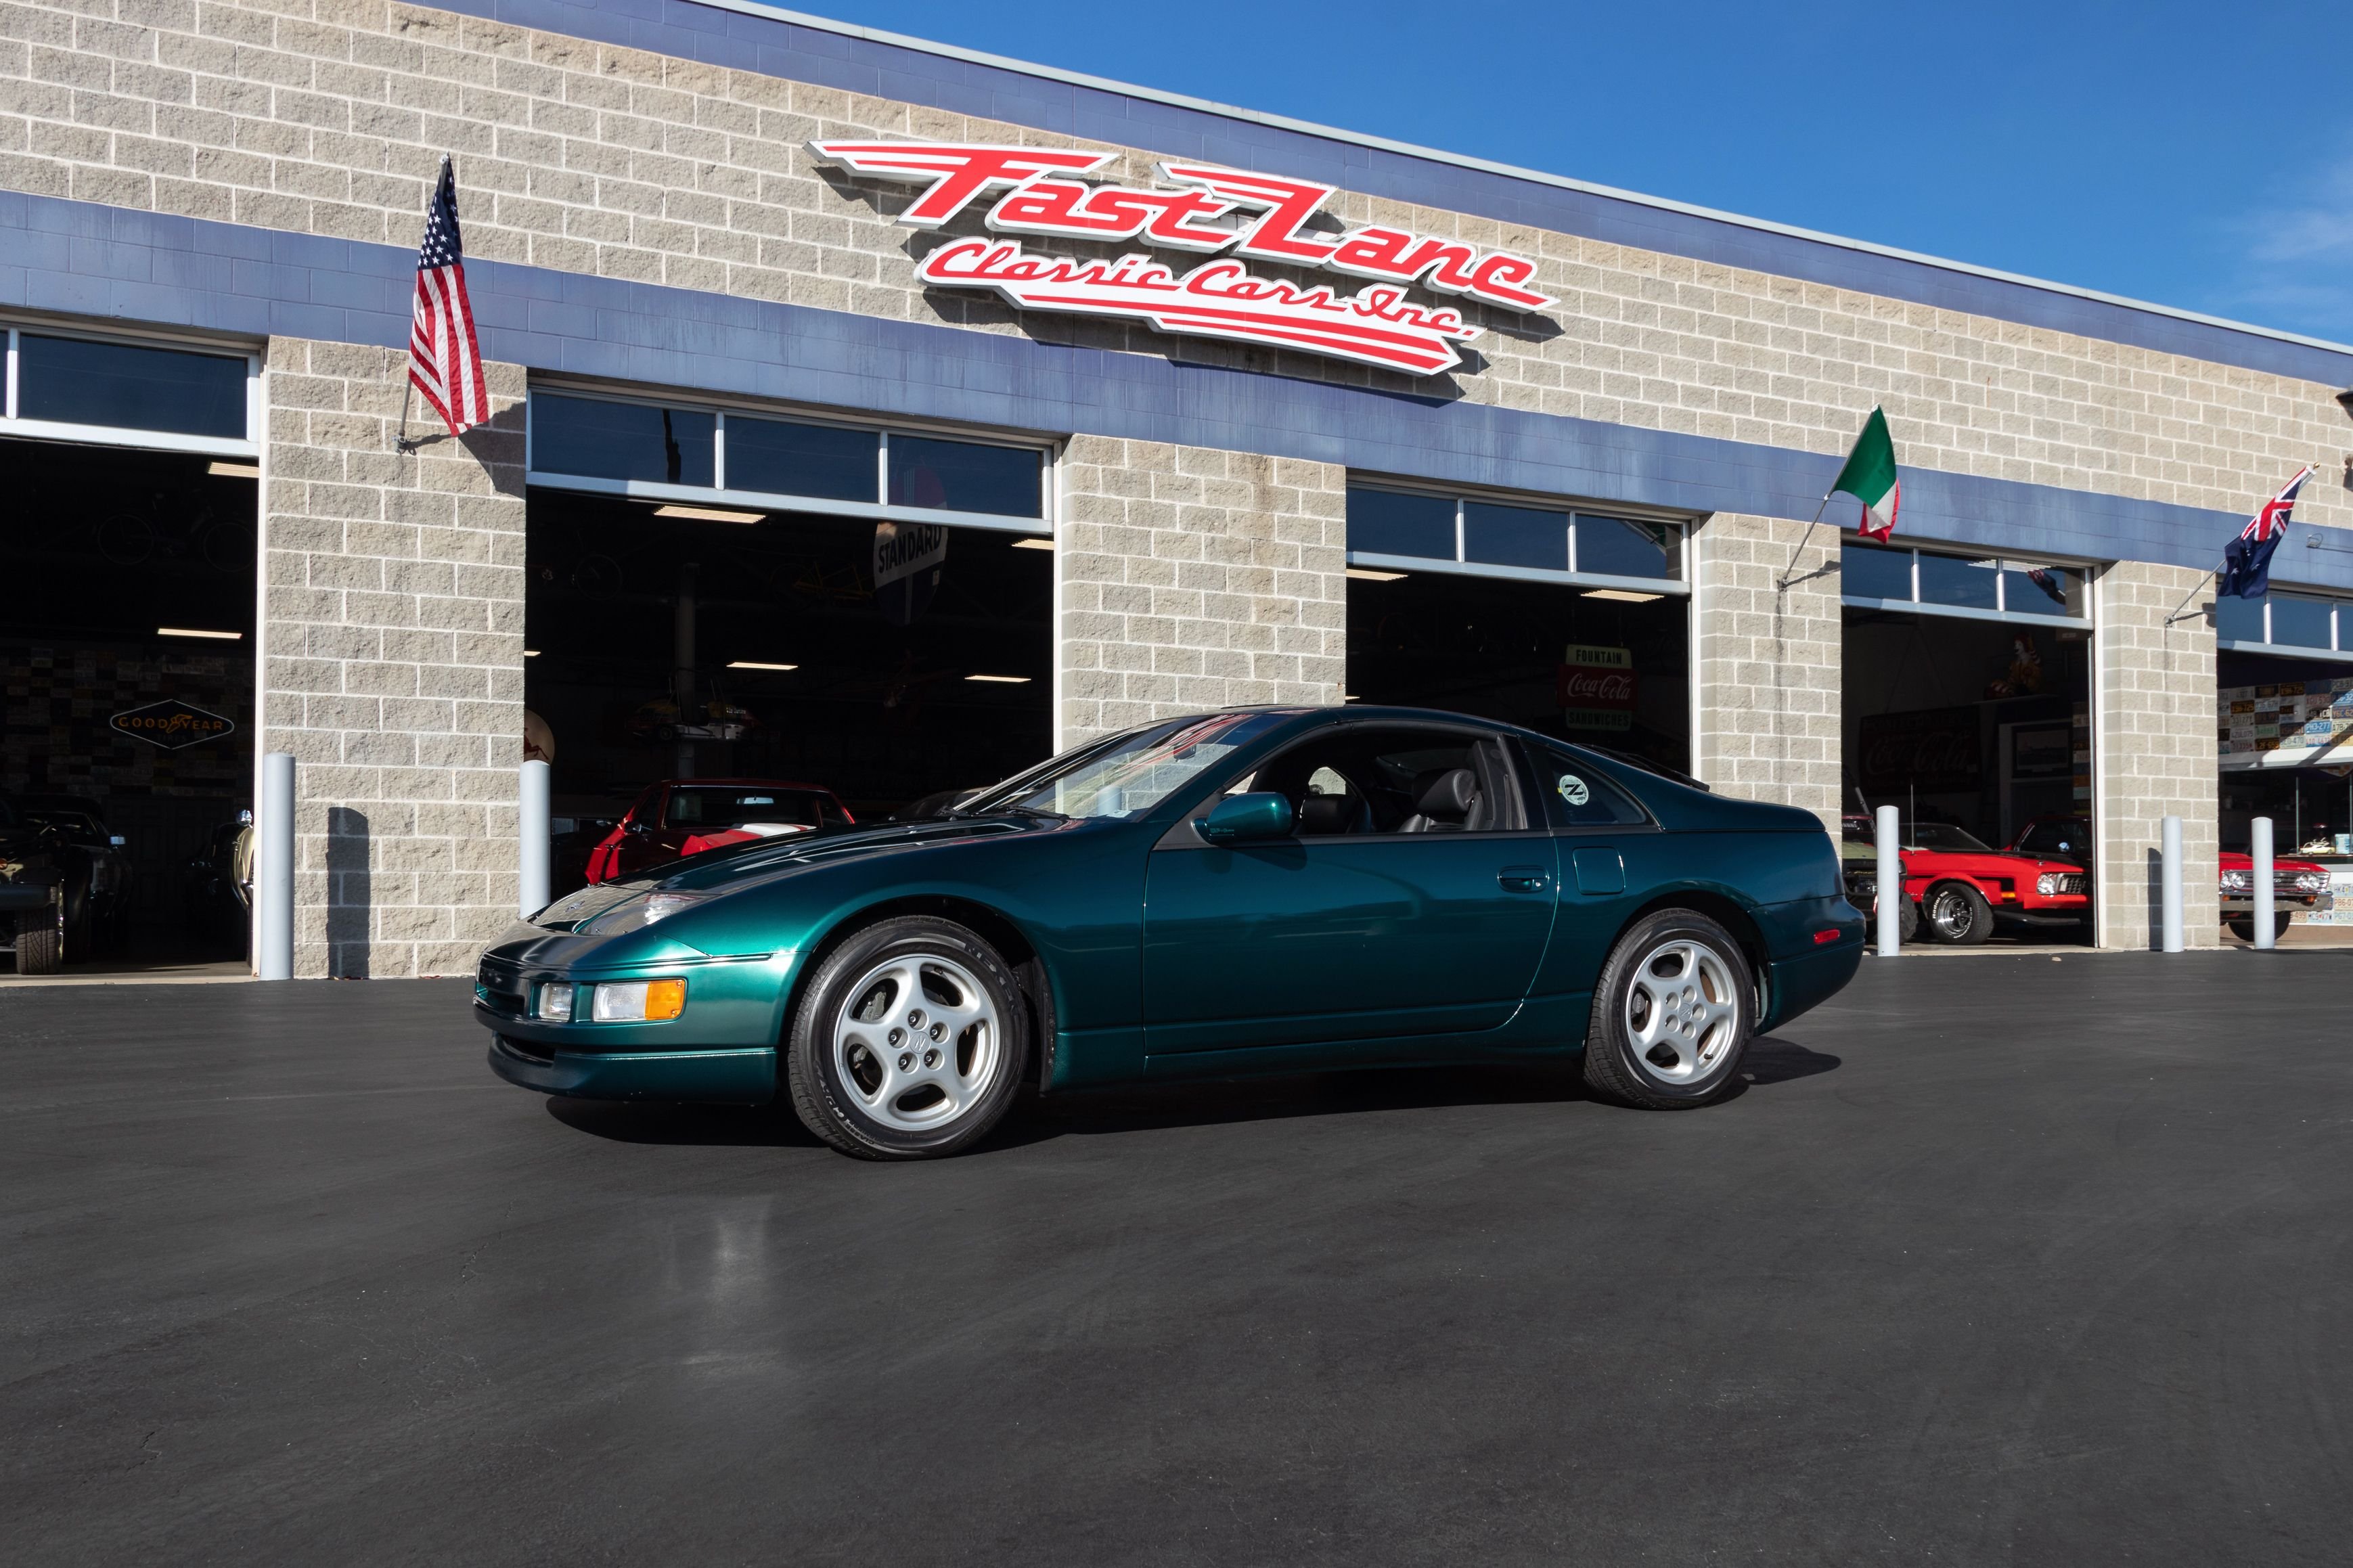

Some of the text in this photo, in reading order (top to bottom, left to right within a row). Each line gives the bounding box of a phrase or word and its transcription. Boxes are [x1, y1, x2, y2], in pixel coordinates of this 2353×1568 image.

[822, 144, 1550, 308] Fast Lane
[924, 243, 1475, 337] Classic Cars Inc.
[878, 524, 942, 574] STANDARD
[1576, 650, 1622, 665] FOUNTAIN
[1567, 673, 1633, 700] Coca-Cola
[118, 715, 224, 732] GOODYEAR
[1569, 711, 1630, 727] SANDWICHES
[963, 941, 1019, 1016] NEXEN
